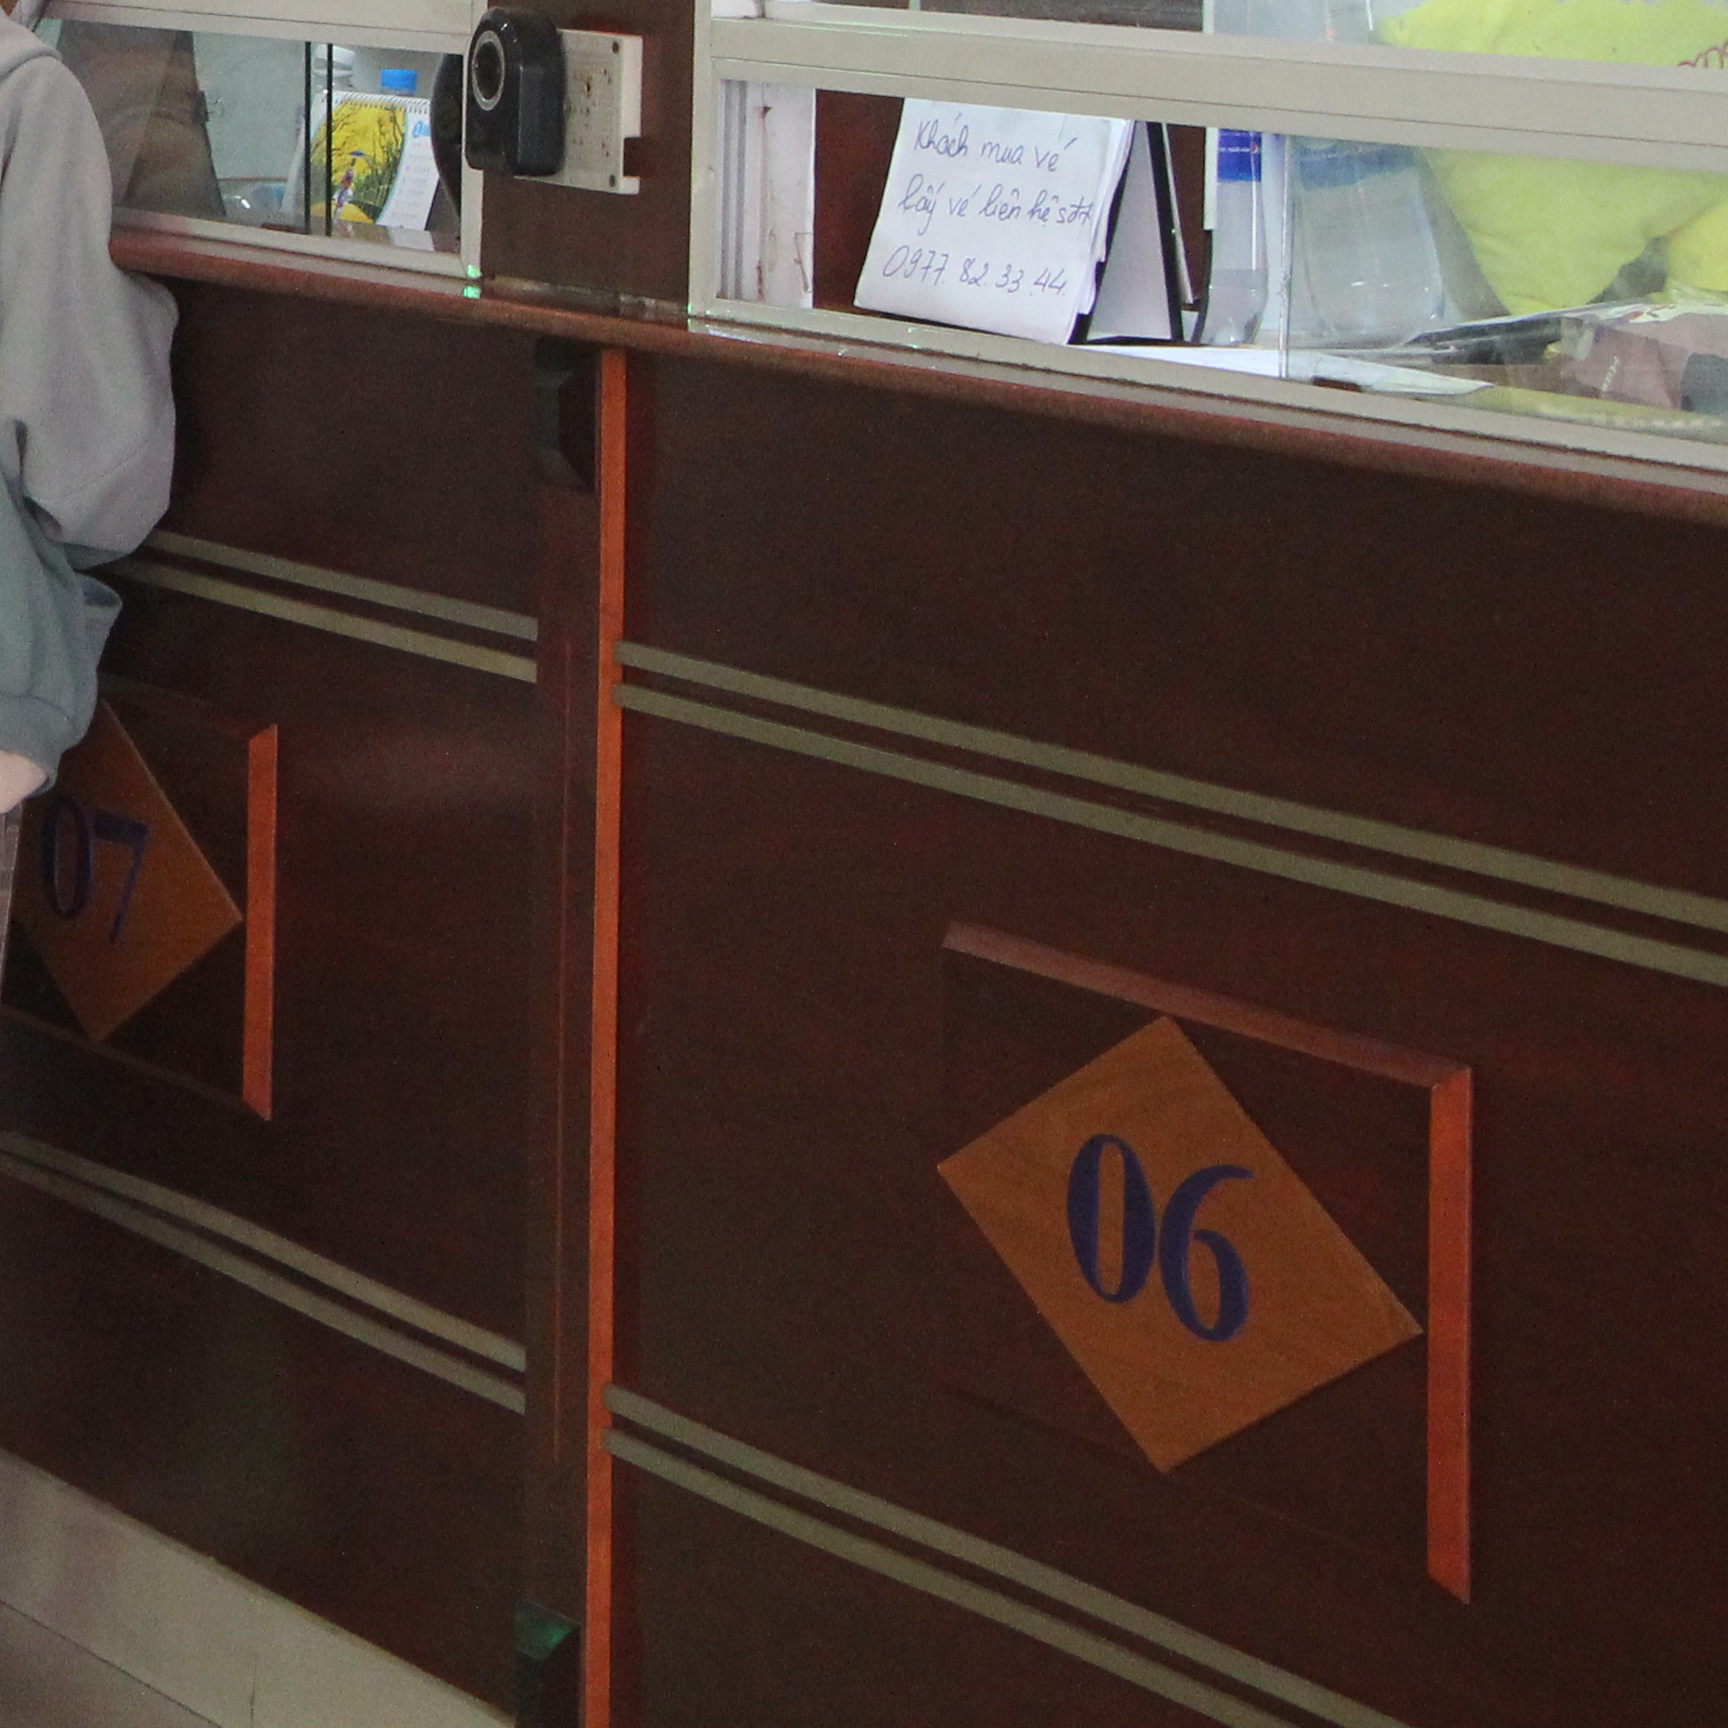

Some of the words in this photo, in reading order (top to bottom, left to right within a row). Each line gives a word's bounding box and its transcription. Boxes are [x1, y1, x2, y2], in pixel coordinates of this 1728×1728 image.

[914, 113, 969, 158] Khách
[981, 139, 1023, 166] mua
[1035, 137, 1078, 172] vé
[948, 185, 981, 219] vé
[981, 183, 1022, 221] liên
[1027, 184, 1060, 227] hệ
[47, 797, 149, 944] 07
[1066, 1133, 1254, 1342] 06
